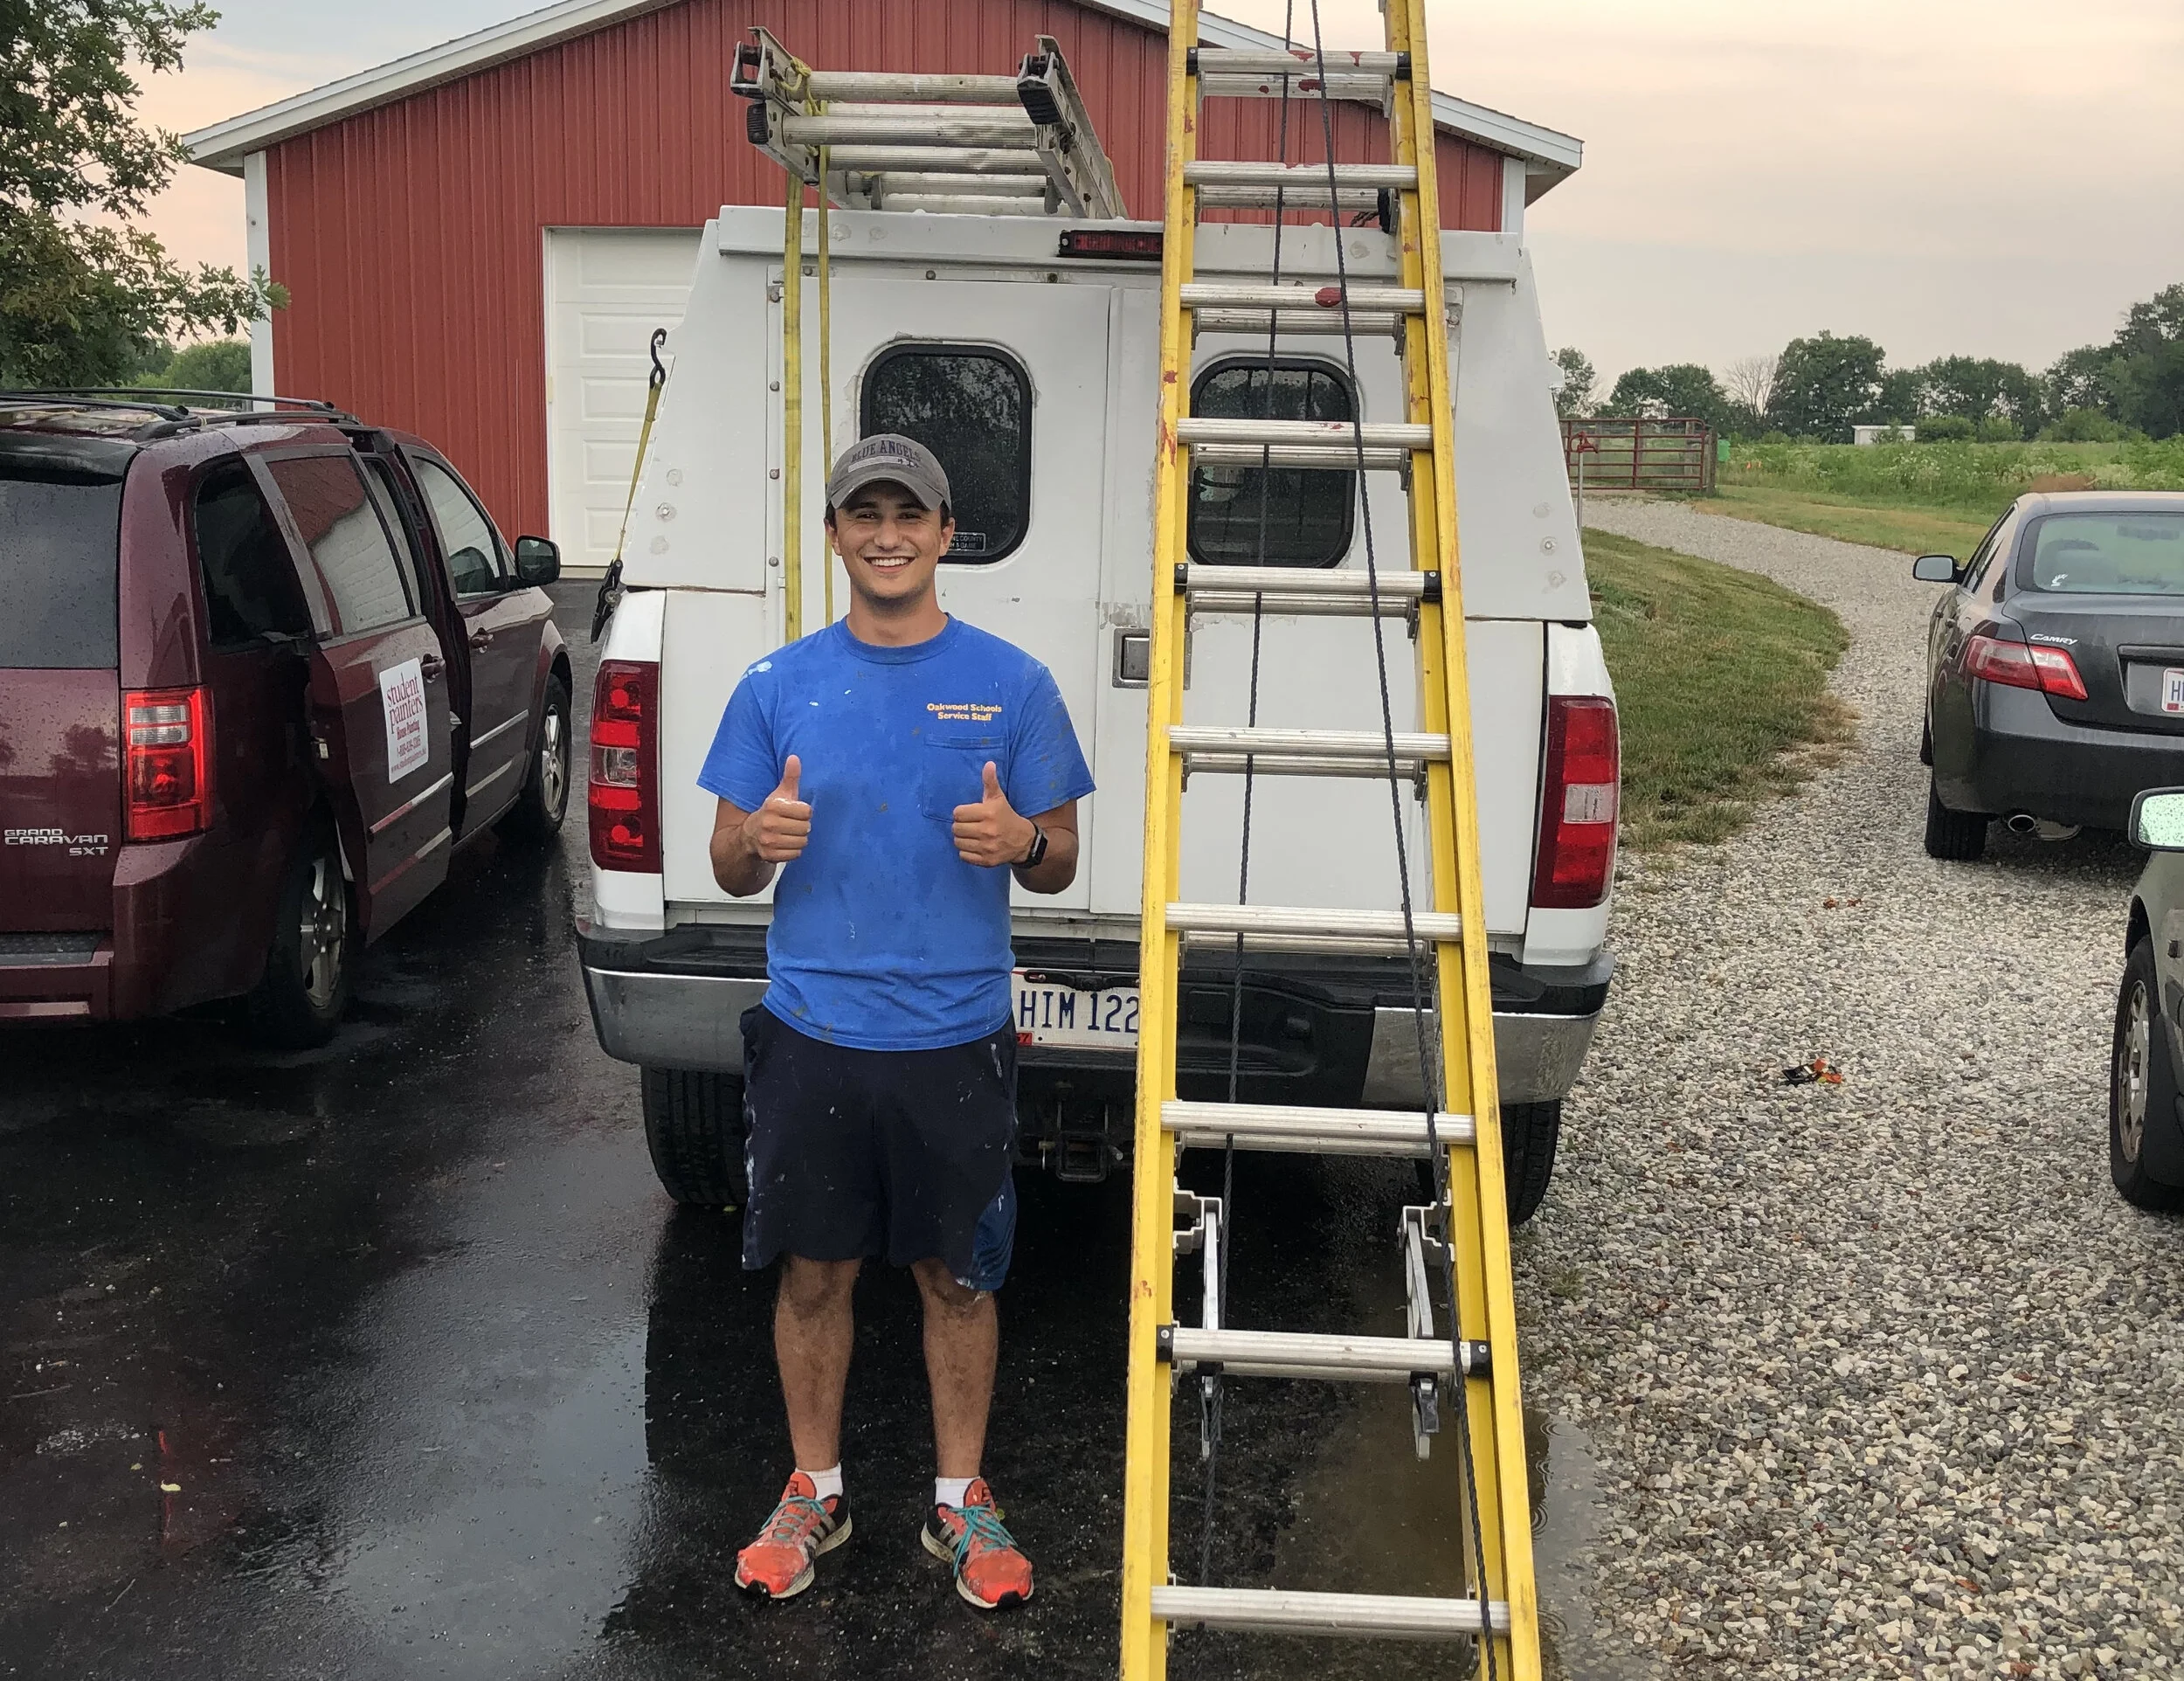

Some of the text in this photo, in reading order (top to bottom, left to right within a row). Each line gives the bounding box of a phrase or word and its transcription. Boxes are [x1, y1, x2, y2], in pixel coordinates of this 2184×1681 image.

[852, 439, 922, 462] BLUE ANGELS
[387, 672, 419, 707] student
[2172, 680, 2184, 702] H
[390, 695, 424, 735] painters
[927, 702, 1002, 712] Oakwood Schools
[971, 712, 992, 721] Staff
[3, 828, 64, 837] GRAND
[4, 834, 108, 846] CARAVAN
[69, 847, 109, 856] SXT
[1019, 990, 1075, 1029] HIM
